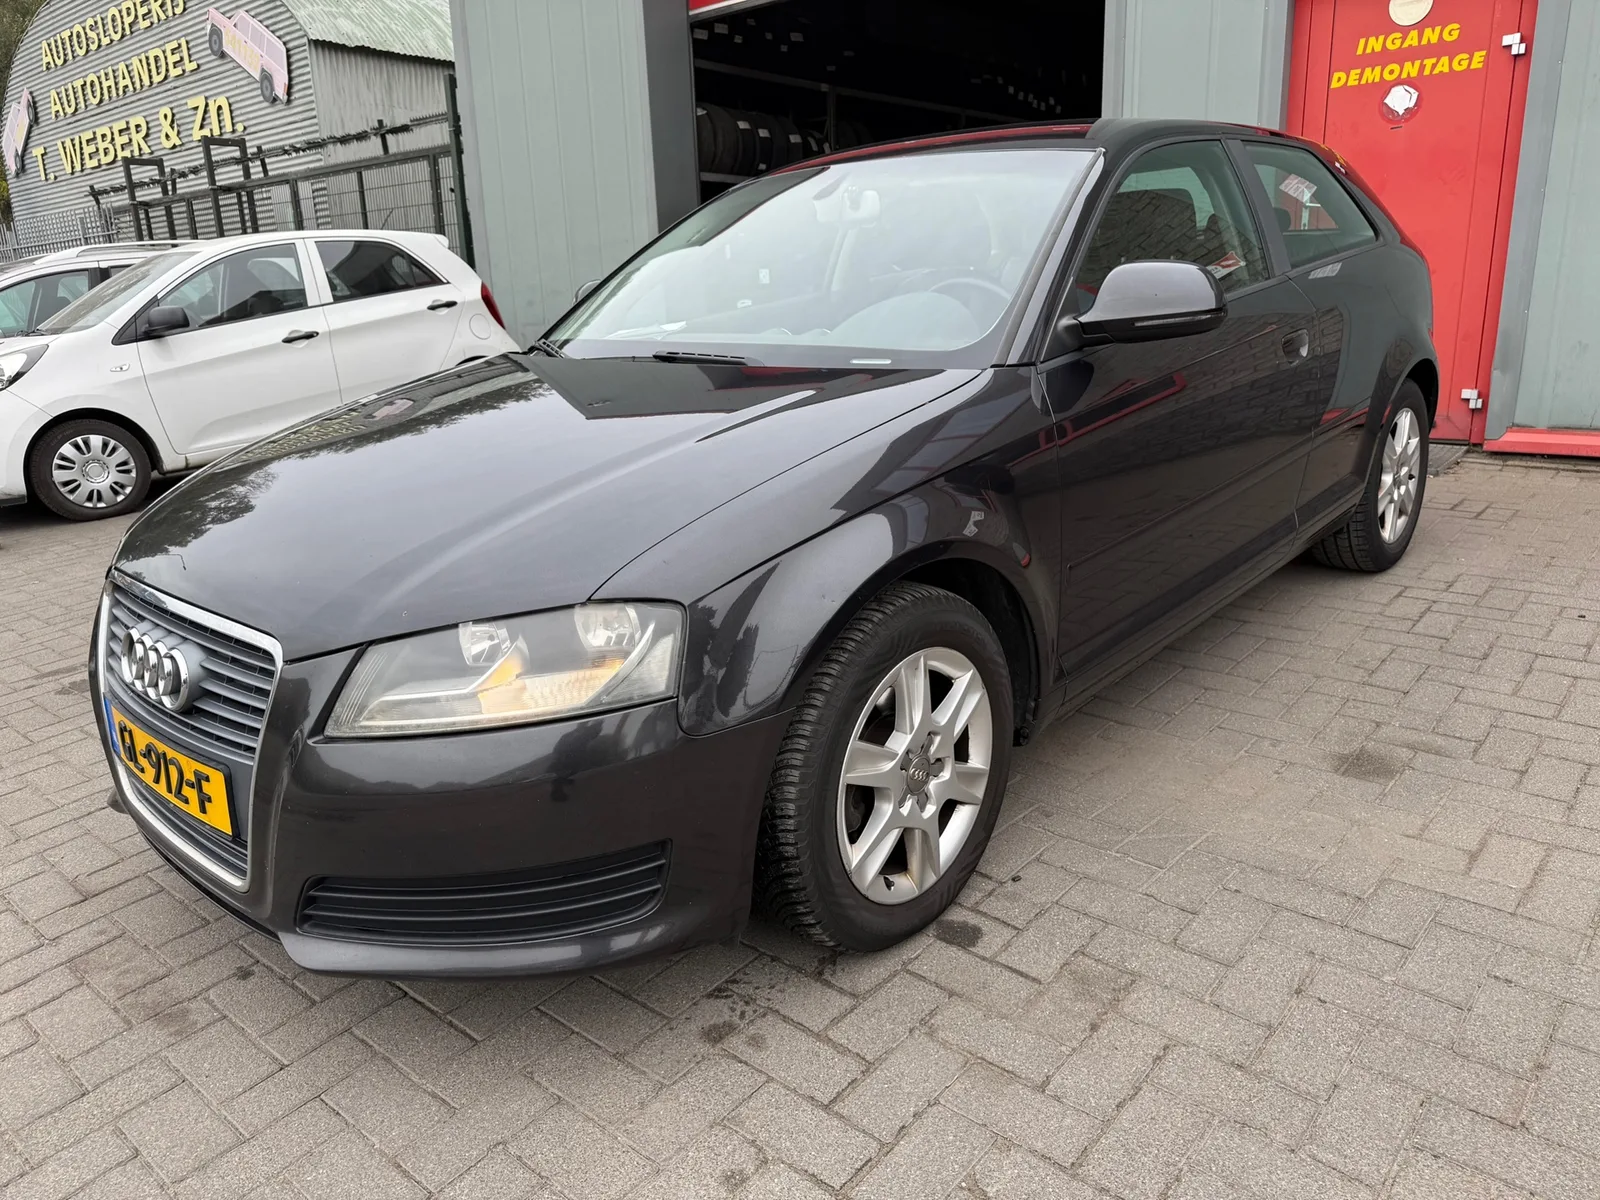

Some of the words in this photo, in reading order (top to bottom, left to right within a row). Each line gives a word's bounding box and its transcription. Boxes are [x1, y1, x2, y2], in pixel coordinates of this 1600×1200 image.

[1356, 23, 1461, 55] INGANG
[50, 37, 198, 119] AUTOHANDEL
[1330, 51, 1487, 89] DEMONTAGE
[32, 146, 56, 181] T.
[57, 115, 151, 174] WEBER
[158, 106, 182, 149] &
[187, 95, 244, 141] Zn.
